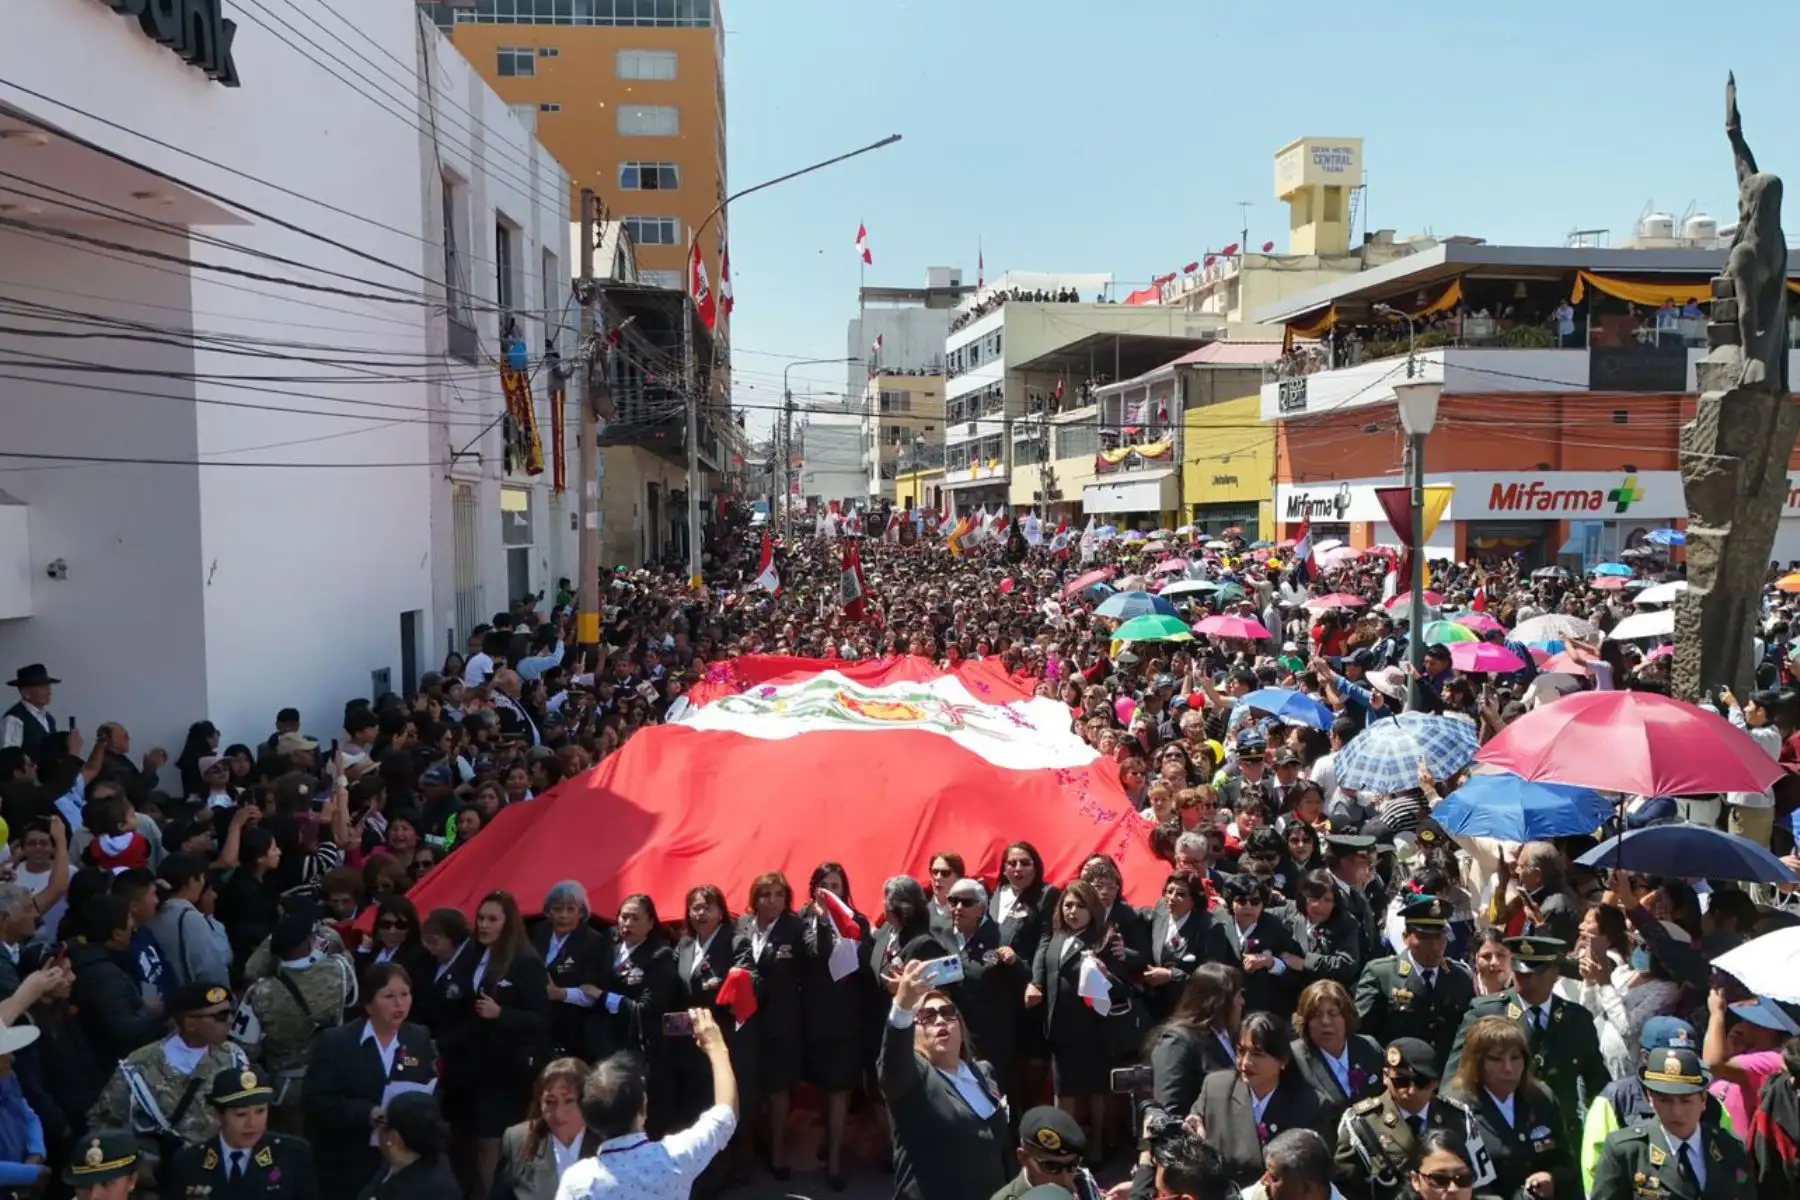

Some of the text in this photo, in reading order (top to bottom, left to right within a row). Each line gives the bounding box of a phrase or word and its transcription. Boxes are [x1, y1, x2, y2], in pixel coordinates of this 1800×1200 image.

[1312, 153, 1353, 166] CENTRAL
[1488, 481, 1603, 511] Mifarma
[1476, 1146, 1490, 1177] P
